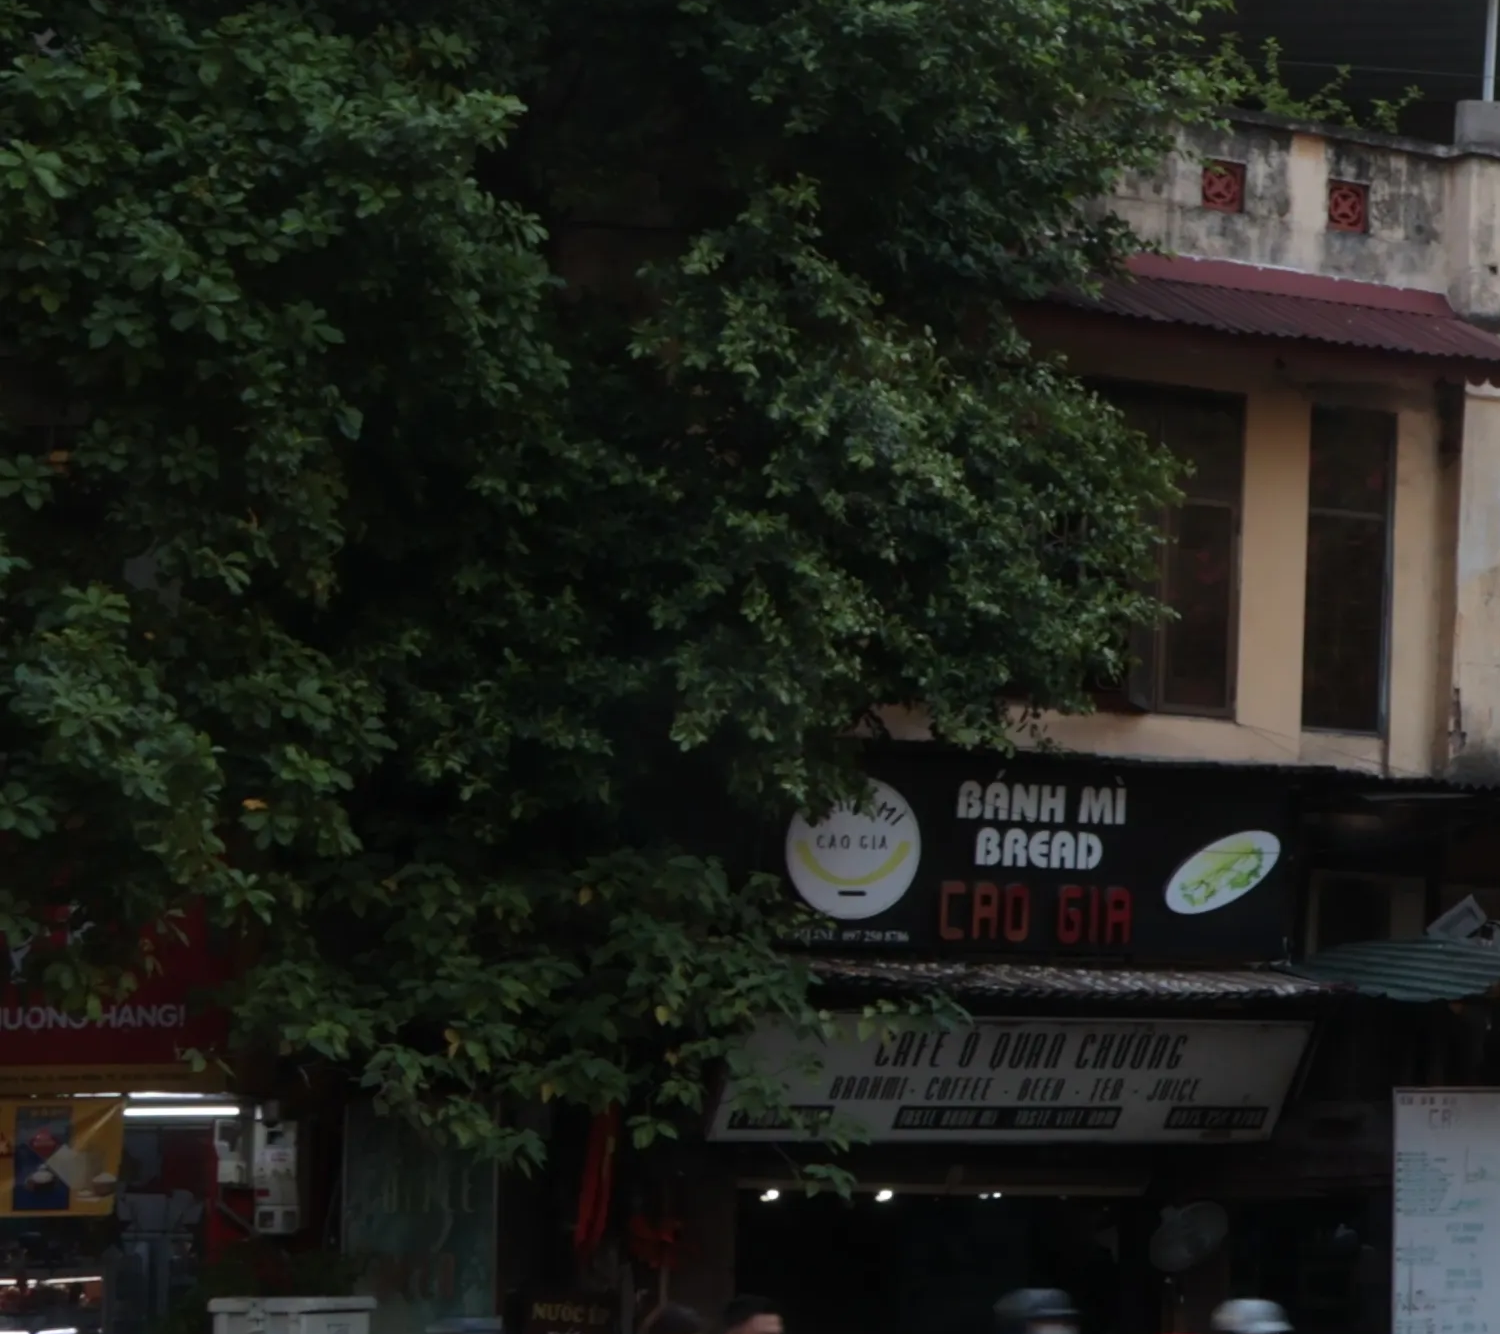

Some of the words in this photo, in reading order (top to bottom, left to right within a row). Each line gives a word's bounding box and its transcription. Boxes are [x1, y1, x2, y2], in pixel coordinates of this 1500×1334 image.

[955, 768, 1067, 824] BÁNH
[1077, 774, 1127, 825] MÌ
[815, 834, 851, 850] CAO
[859, 834, 889, 850] GIA
[973, 826, 1104, 871] BREAD
[940, 879, 1030, 942] CAO
[1058, 883, 1135, 945] GIA
[1145, 1076, 1203, 1102] JUICE
